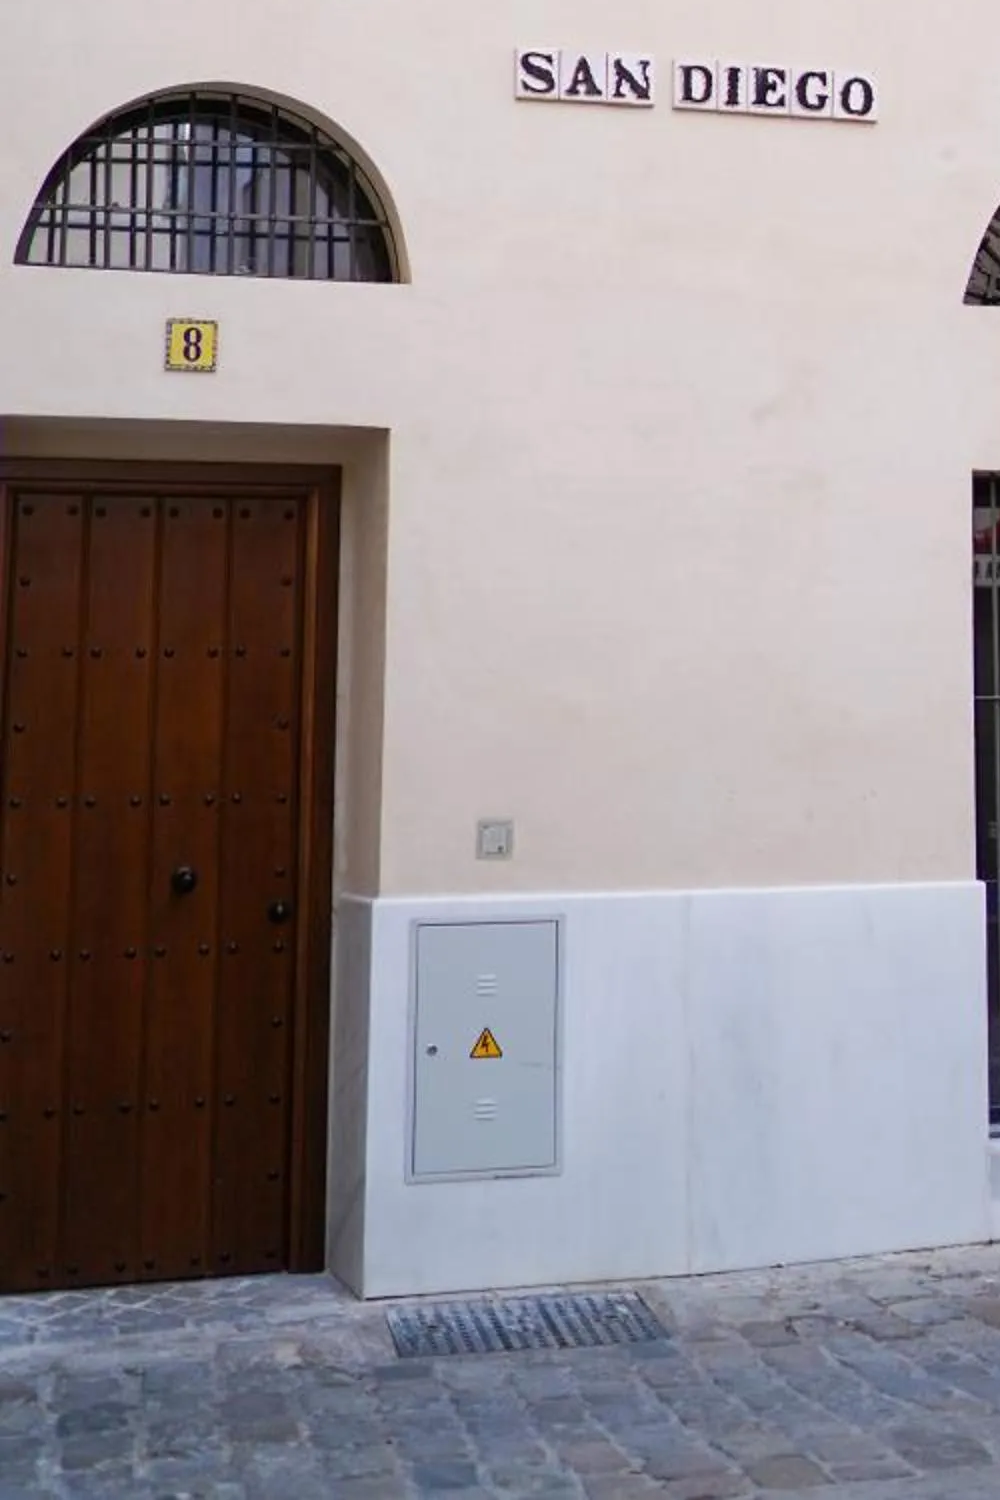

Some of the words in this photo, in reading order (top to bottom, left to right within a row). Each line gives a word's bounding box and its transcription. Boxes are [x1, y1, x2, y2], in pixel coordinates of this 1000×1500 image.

[520, 52, 651, 100] SAN
[680, 64, 874, 116] DIEGO
[183, 327, 202, 362] 8
